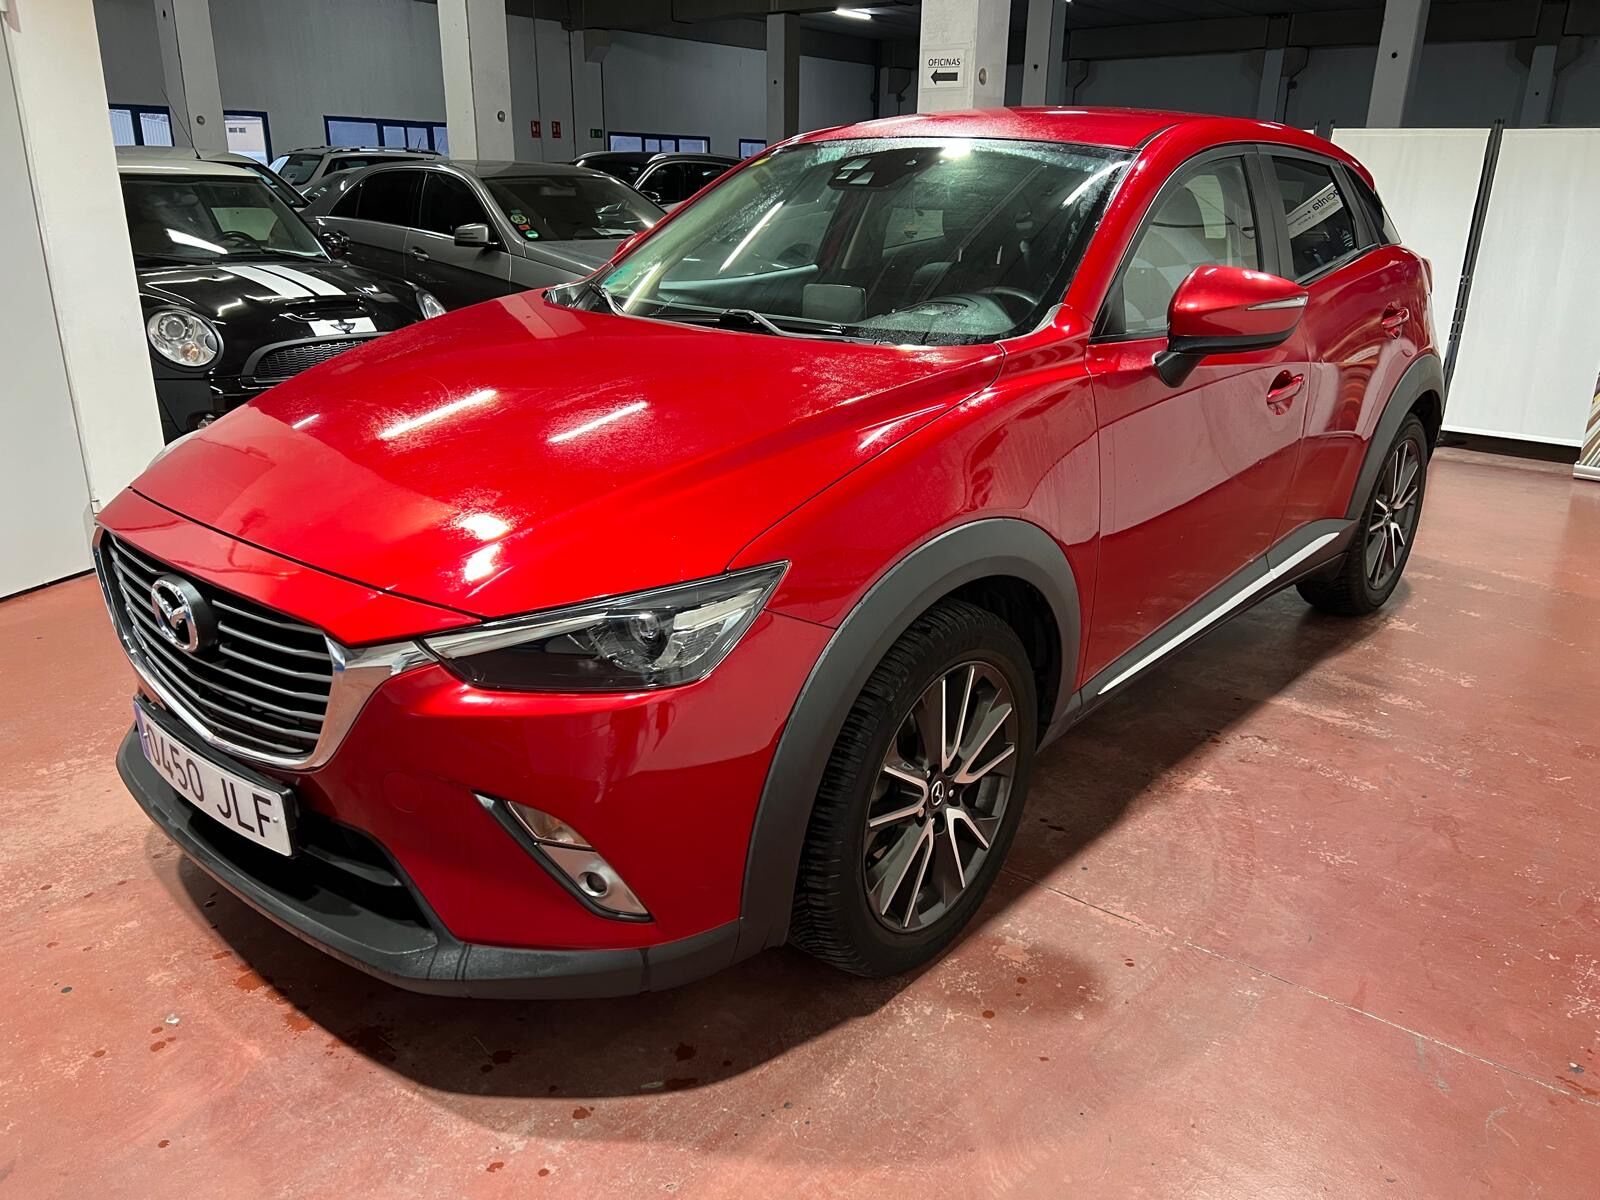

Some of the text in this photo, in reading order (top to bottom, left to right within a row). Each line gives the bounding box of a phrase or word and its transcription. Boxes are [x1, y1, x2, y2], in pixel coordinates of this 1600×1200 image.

[928, 58, 961, 67] OFICINAS
[146, 723, 272, 838] 0450 JLF
